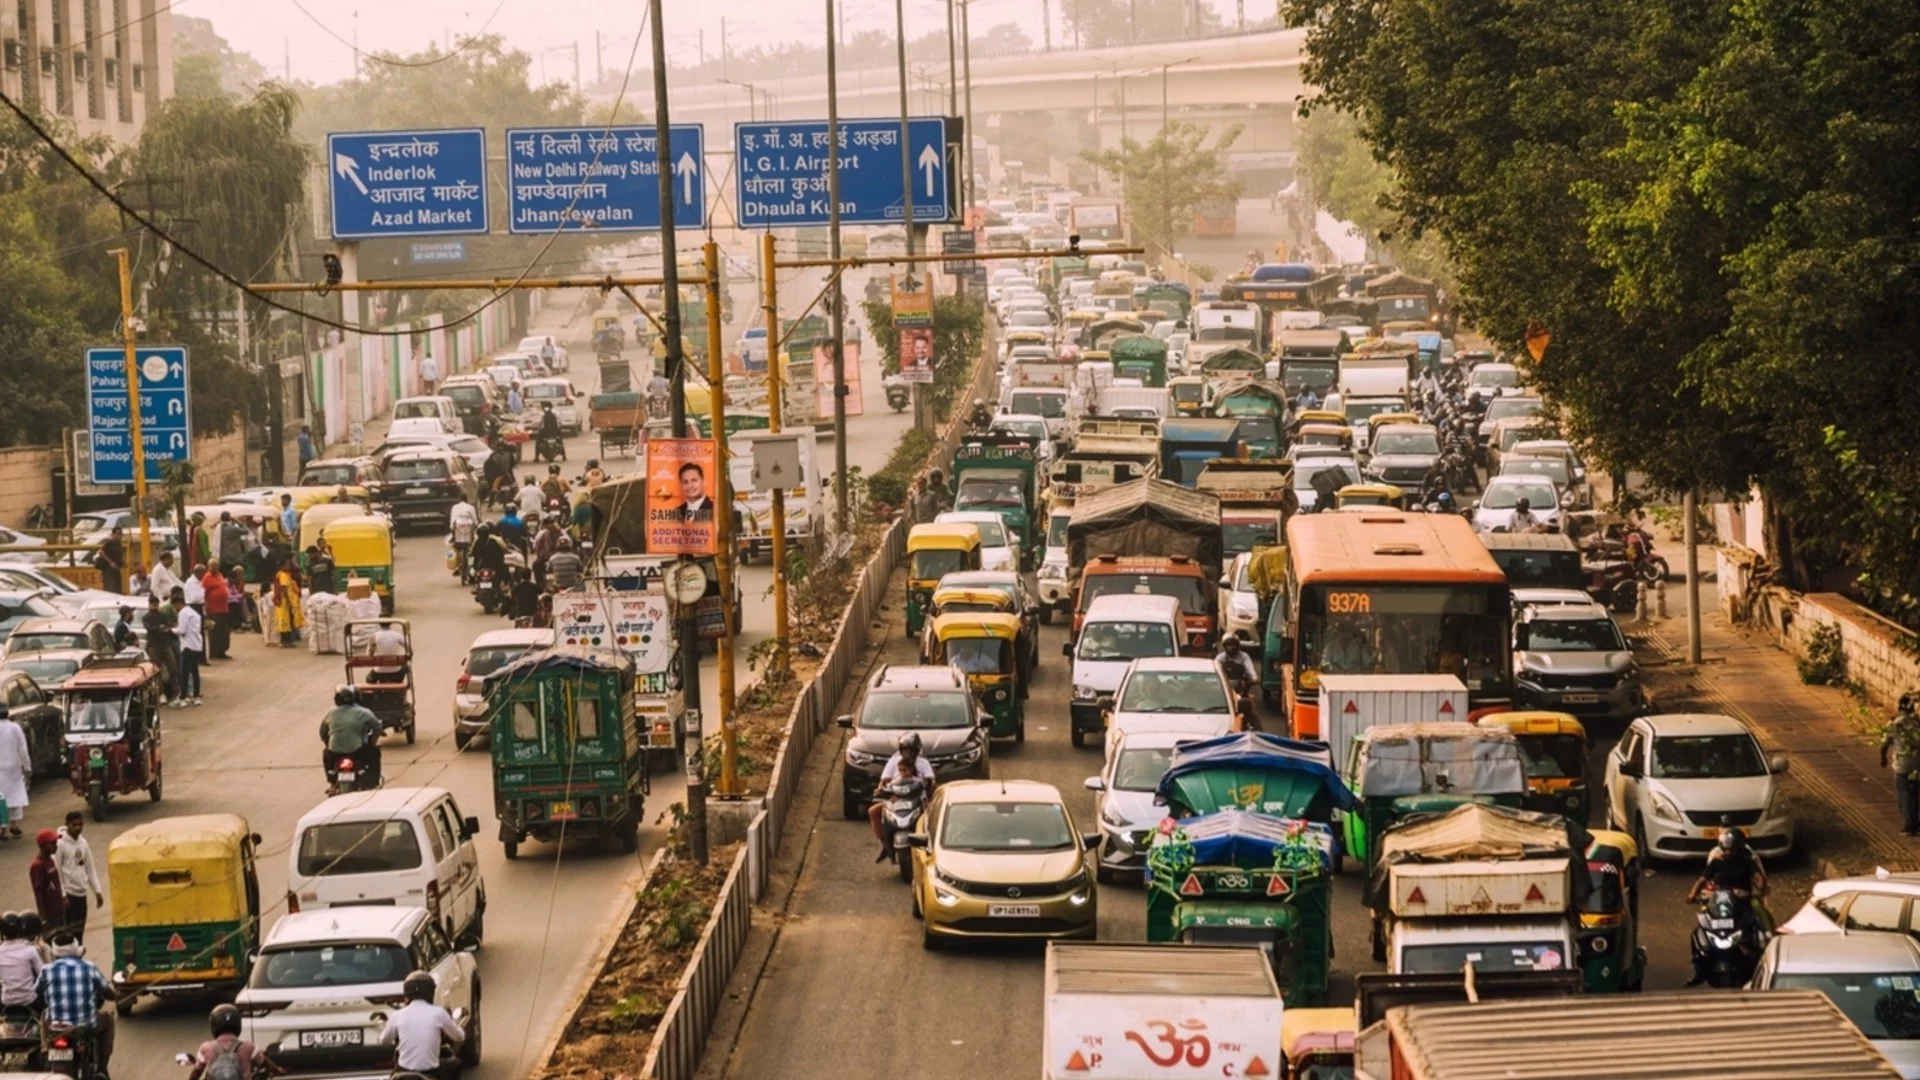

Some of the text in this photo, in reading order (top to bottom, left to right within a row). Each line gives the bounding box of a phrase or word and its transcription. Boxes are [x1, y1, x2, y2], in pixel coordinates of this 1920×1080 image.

[368, 136, 439, 161] इन्द्रलोक
[514, 131, 659, 157] नई दिल्ली रेलवे स्टेश
[368, 165, 436, 181] Inderlok
[515, 159, 678, 179] New Delhi Railway Statin
[370, 179, 480, 204] आजाद मार्केट
[516, 180, 607, 201] झण्डेवालान
[744, 173, 785, 195] धौला
[516, 206, 633, 223] Jhandewalan
[746, 200, 806, 217] Dhaula
[371, 209, 472, 226] Azad Market
[93, 416, 127, 428] Rajpur
[652, 527, 710, 537] ADDITIONAL
[652, 536, 709, 546] SECRETARY
[1329, 592, 1370, 613] 937A
[1226, 917, 1251, 926] CNG
